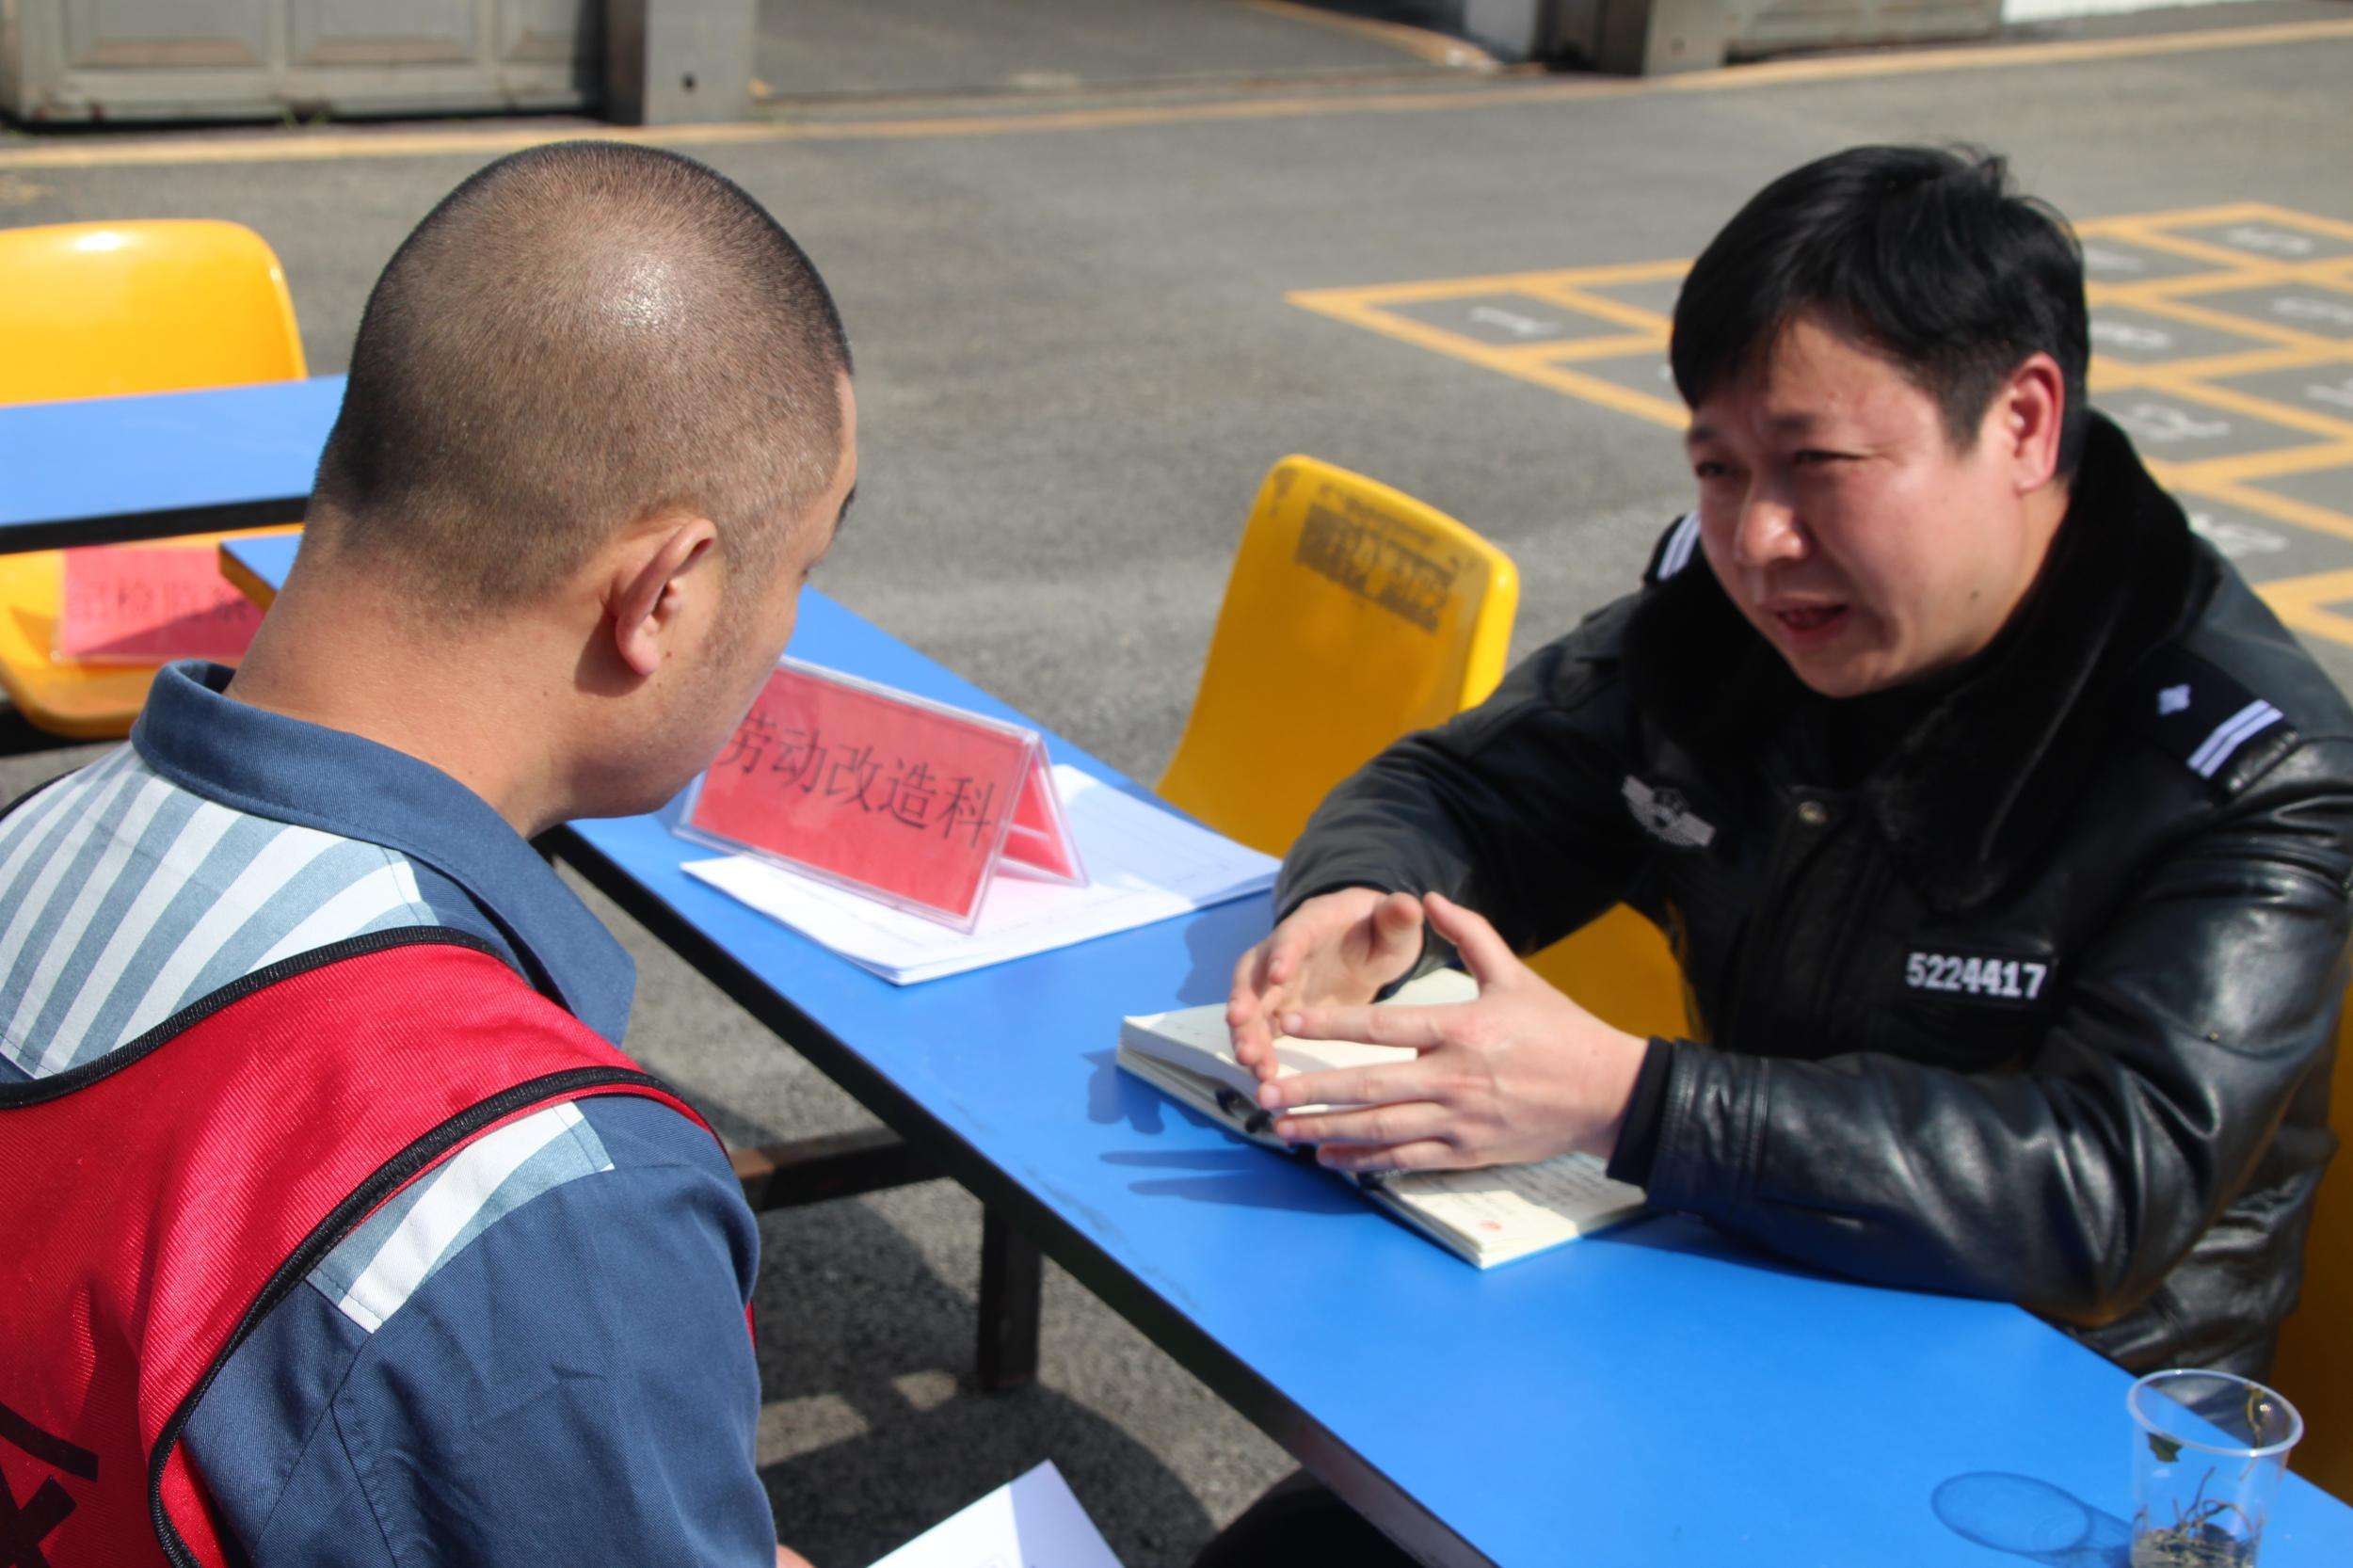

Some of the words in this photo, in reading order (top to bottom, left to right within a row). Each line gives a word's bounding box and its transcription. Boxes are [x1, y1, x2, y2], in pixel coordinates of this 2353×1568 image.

[717, 710, 996, 848] 劳动改造科
[1905, 952, 2047, 1000] 5224417
